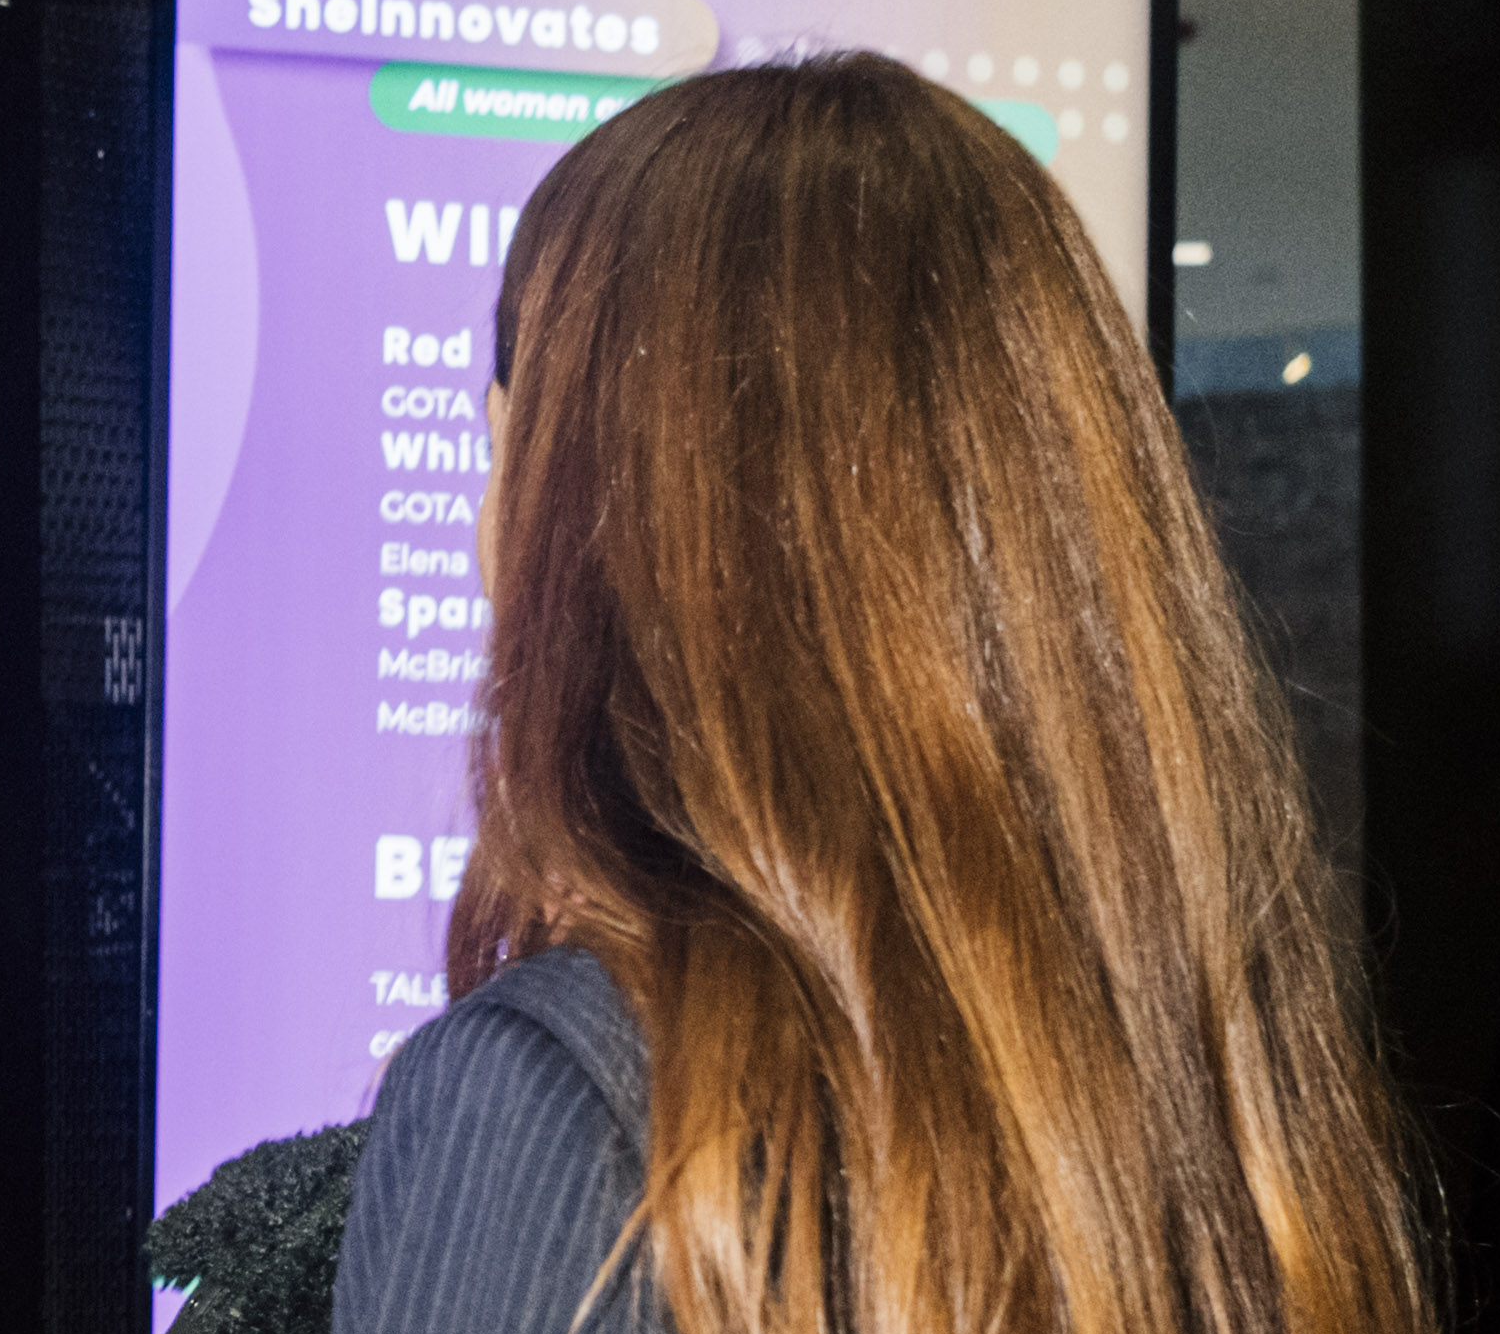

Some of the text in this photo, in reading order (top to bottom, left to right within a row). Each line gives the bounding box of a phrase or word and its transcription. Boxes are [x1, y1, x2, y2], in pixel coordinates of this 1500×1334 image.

[408, 79, 458, 114] All
[463, 86, 590, 123] women
[383, 326, 472, 368] Red
[379, 541, 470, 578] Elena
